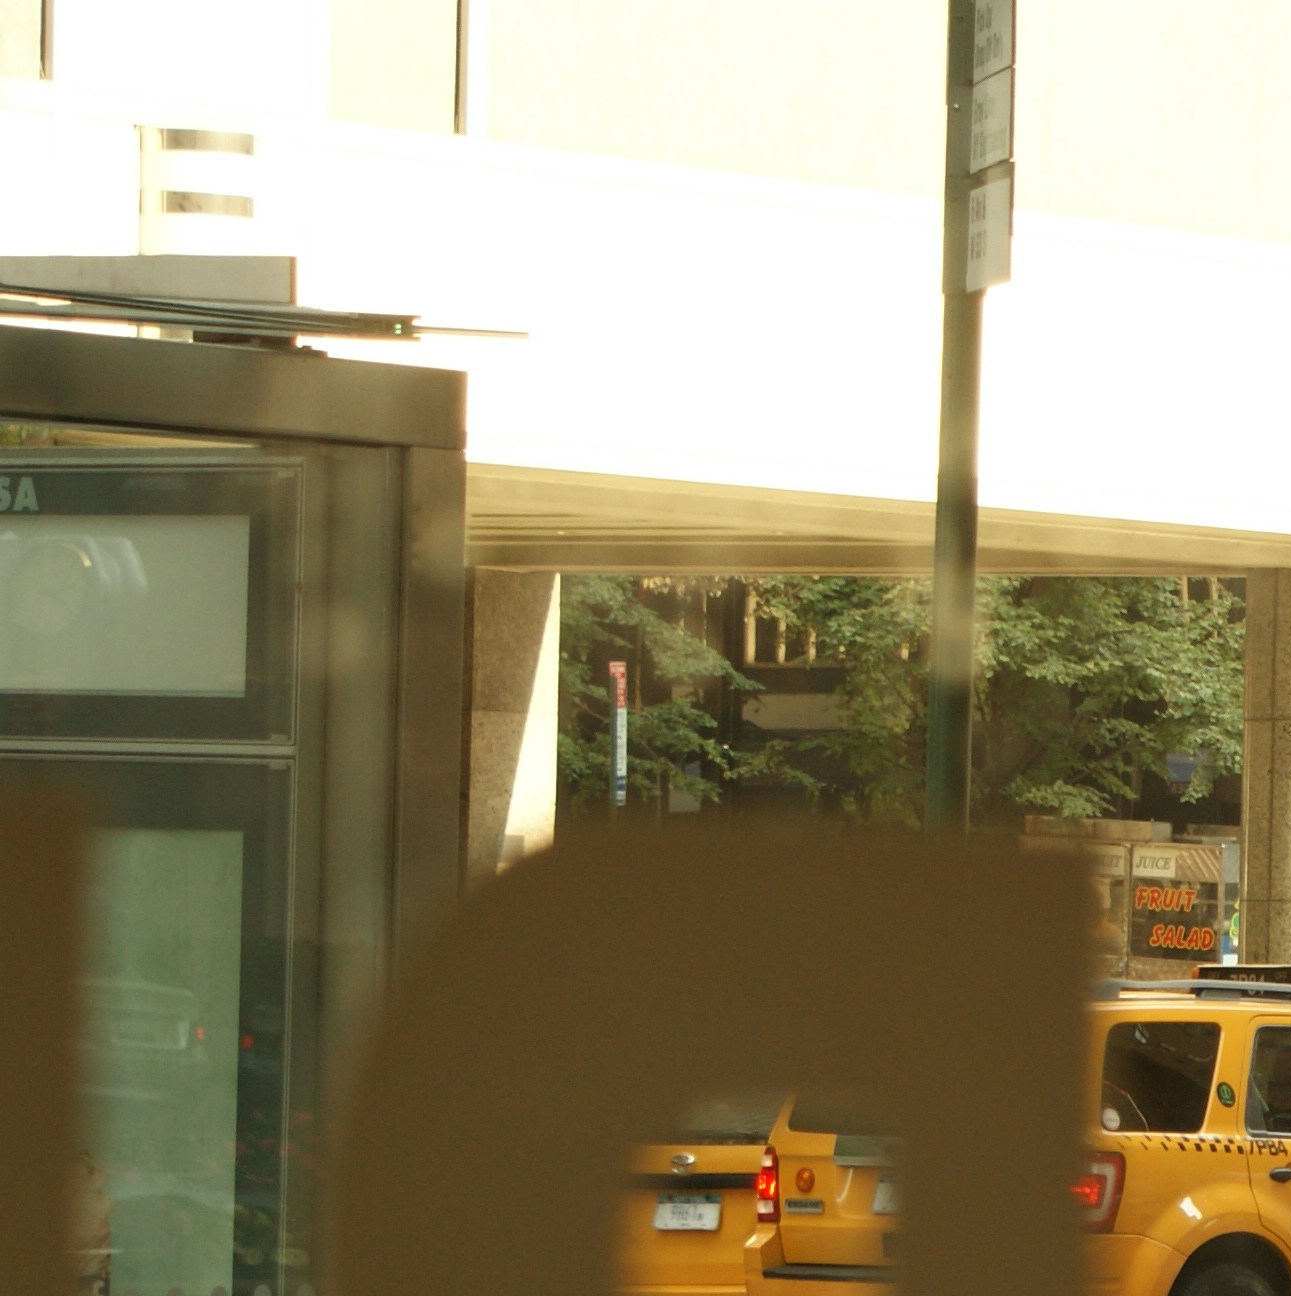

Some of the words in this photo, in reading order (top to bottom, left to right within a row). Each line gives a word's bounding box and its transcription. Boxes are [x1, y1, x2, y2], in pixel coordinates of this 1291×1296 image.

[1135, 856, 1172, 870] JUICE
[1134, 886, 1197, 912] FRUIT
[1149, 923, 1215, 951] SALAD
